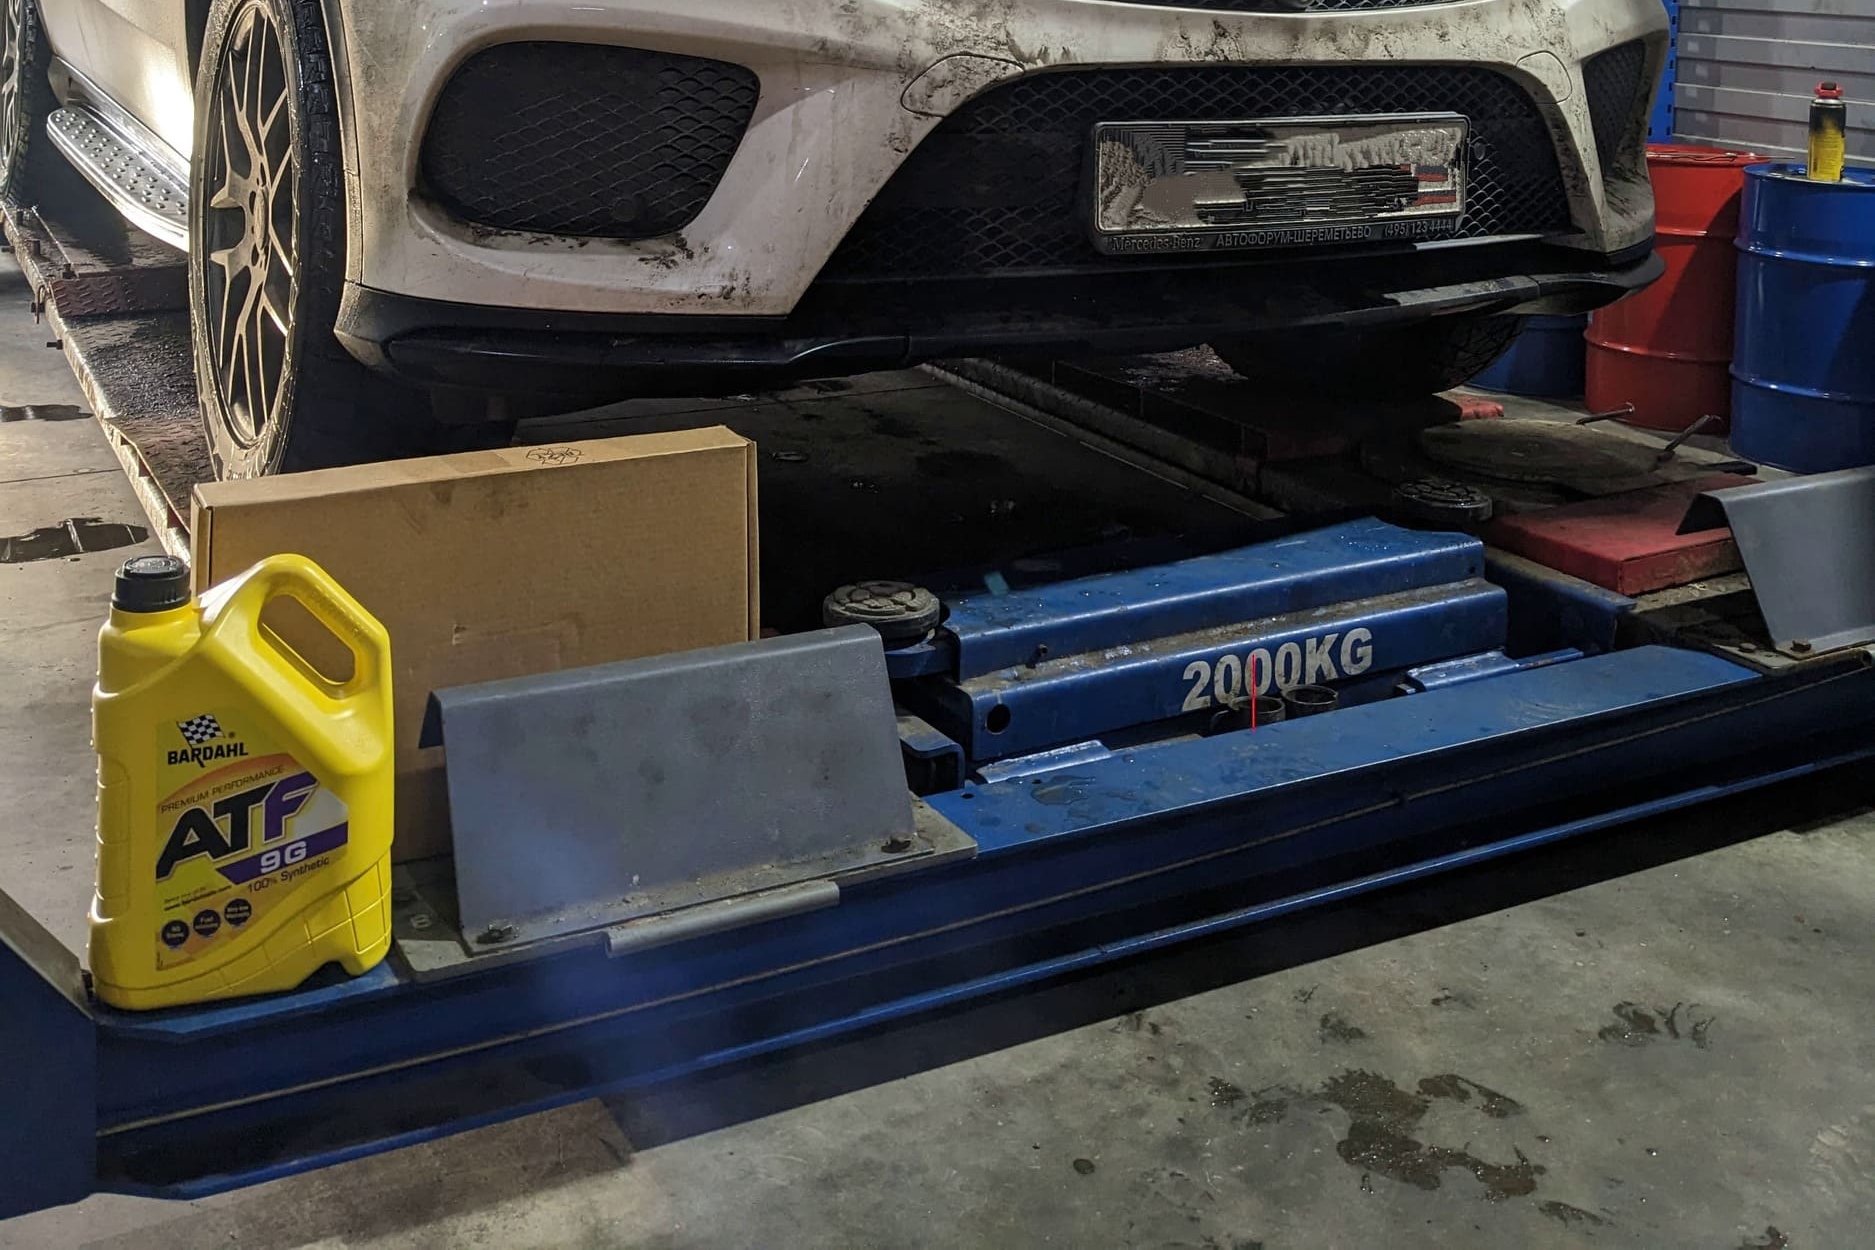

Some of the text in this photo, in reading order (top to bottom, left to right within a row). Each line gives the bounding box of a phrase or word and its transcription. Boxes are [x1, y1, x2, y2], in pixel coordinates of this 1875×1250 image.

[1112, 236, 1201, 251] Mercedes-Benz
[1216, 225, 1372, 247] АВТОФОРУМ-ШЕРЕМЕТЬЕВО
[1384, 222, 1409, 237] (495)
[1182, 627, 1373, 712] 2000KG
[167, 742, 249, 768] BARDAHL
[160, 764, 286, 814] PREMIUM PERFORMANCE
[156, 770, 319, 881] ATF
[260, 840, 307, 874] 9G
[280, 857, 330, 883] Synthetic
